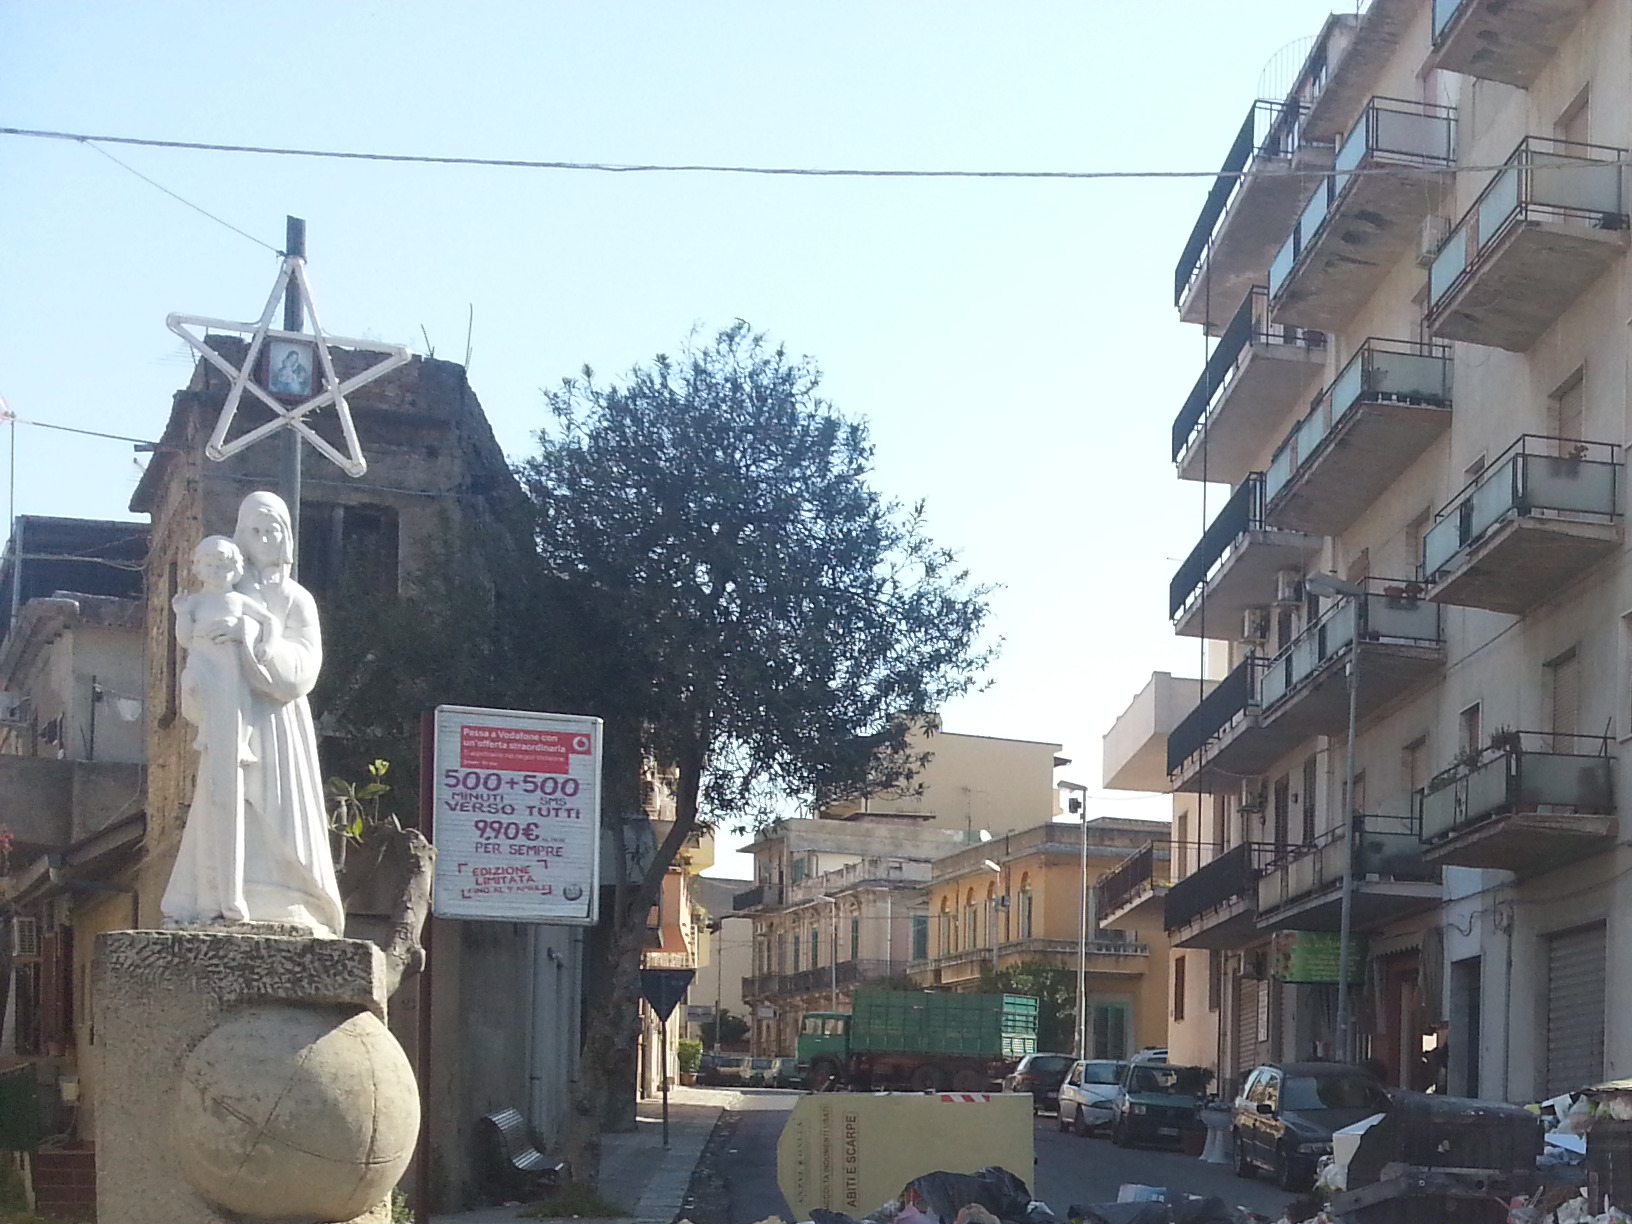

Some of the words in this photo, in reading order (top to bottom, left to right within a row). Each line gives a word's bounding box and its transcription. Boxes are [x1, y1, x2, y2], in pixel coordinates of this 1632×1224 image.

[463, 728, 489, 738] Passa
[498, 730, 540, 741] Vodafone
[463, 739, 508, 749] un'offerta
[509, 743, 566, 753] straordinaria
[451, 792, 504, 803] MINUTI
[540, 797, 567, 807] SMS
[444, 800, 516, 815] VERSO
[525, 805, 581, 820] TUTTI
[475, 842, 503, 854] PER
[509, 844, 564, 857] SEMPRE
[472, 866, 531, 876] EDIZIONE
[475, 875, 536, 886] LIMITATA
[846, 1115, 857, 1164] SCARPE
[846, 1167, 857, 1175] E
[846, 1180, 857, 1208] ABITI
